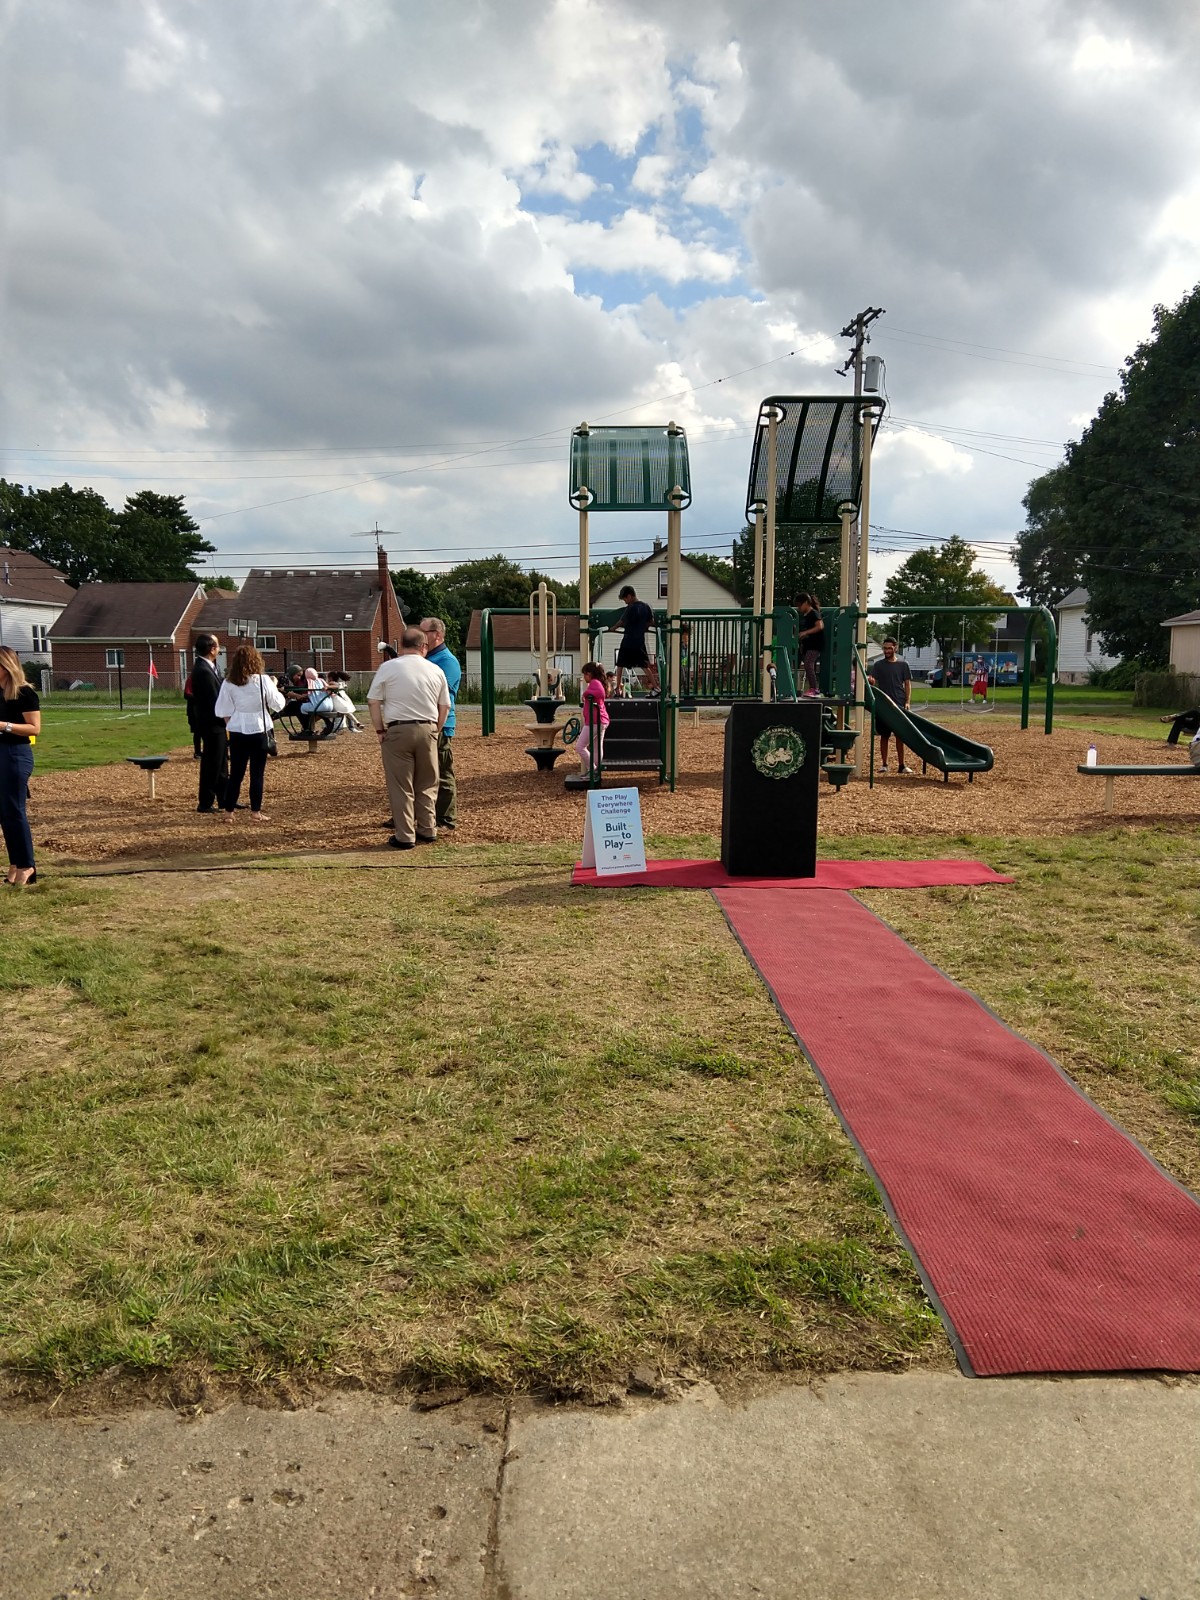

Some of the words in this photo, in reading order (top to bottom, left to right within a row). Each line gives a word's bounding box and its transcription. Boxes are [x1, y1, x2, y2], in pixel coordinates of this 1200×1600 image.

[605, 822, 627, 831] Built
[621, 831, 632, 839] to
[604, 839, 624, 850] Play
